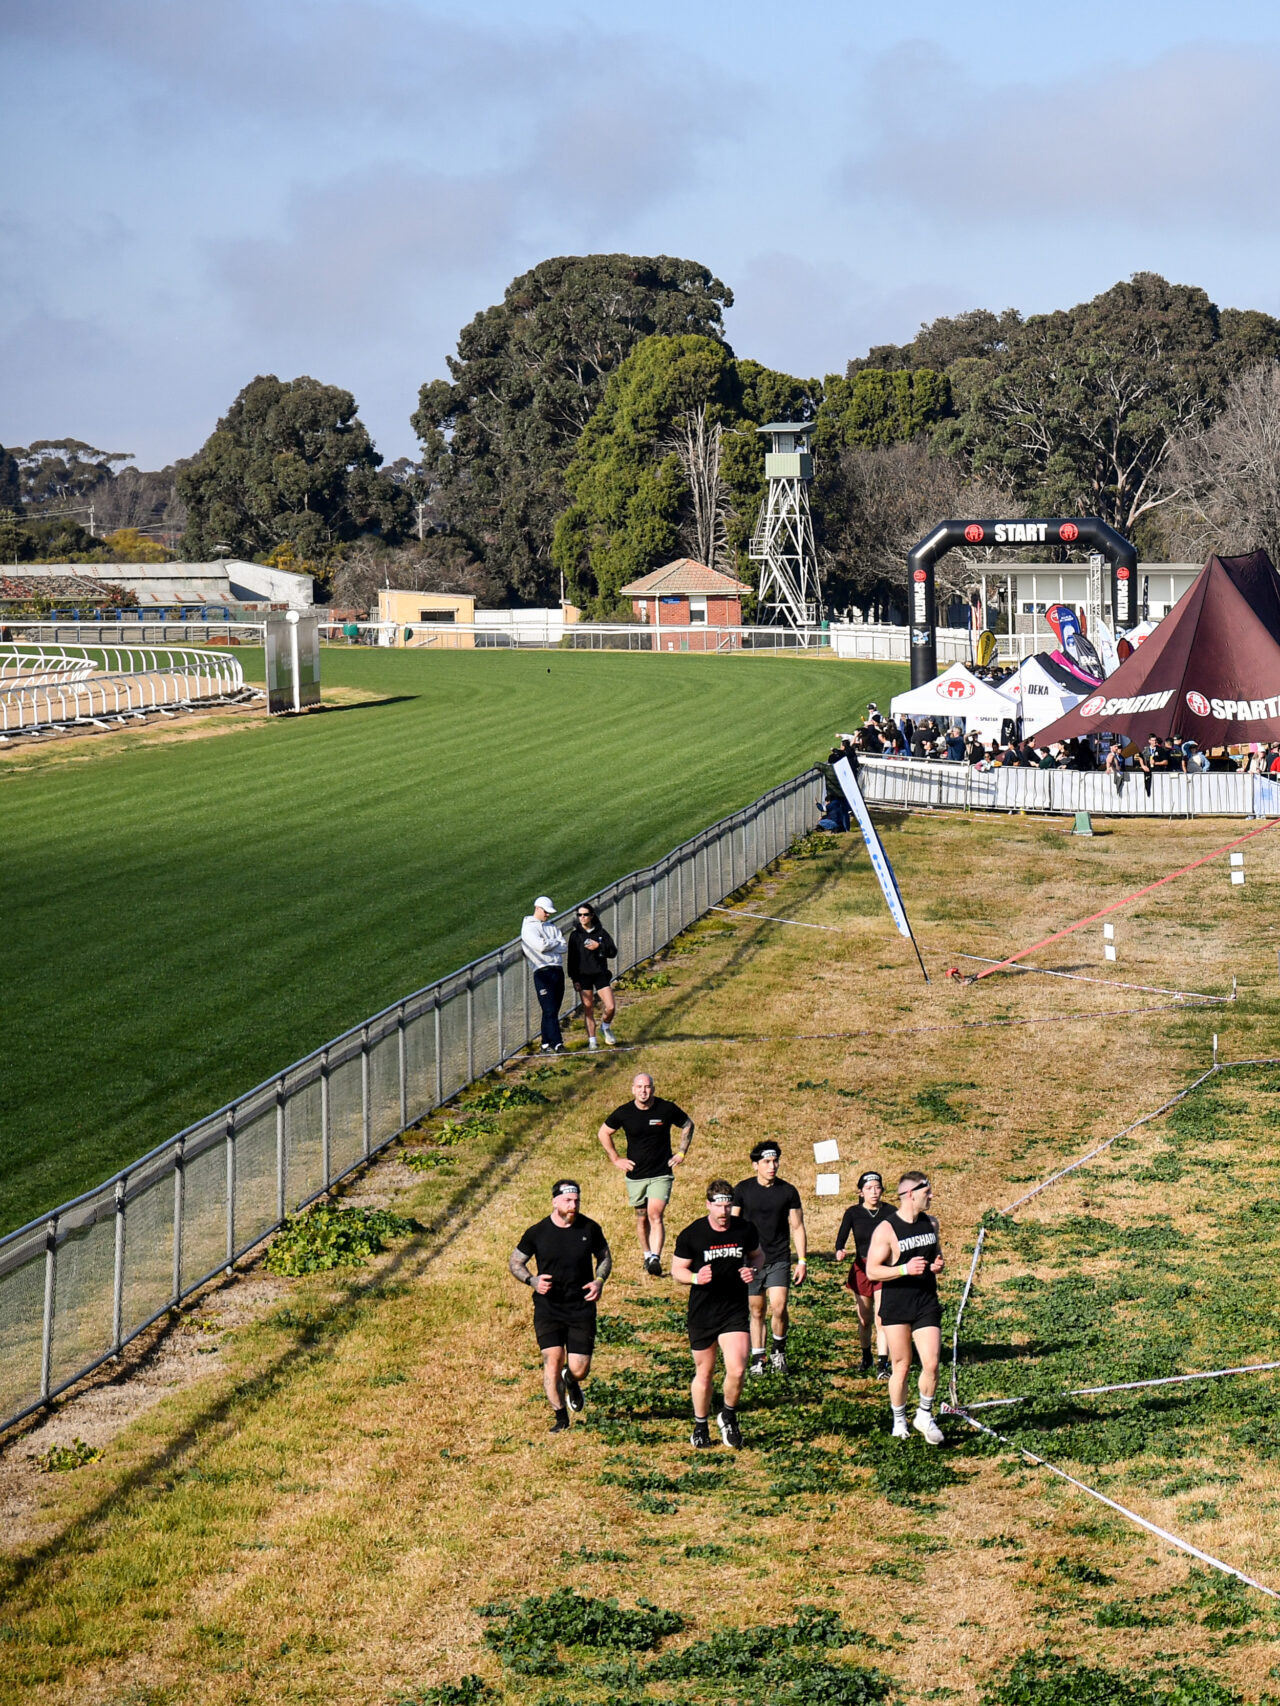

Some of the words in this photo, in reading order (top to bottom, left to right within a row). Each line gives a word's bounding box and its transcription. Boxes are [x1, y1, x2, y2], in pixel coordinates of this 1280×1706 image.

[994, 523, 1048, 542] START
[914, 582, 926, 624] SPARTAN
[1117, 579, 1129, 621] SPARTAN
[1028, 684, 1049, 696] DEKA
[1100, 689, 1176, 716] SPARTAN
[703, 1246, 744, 1263] NINJAS
